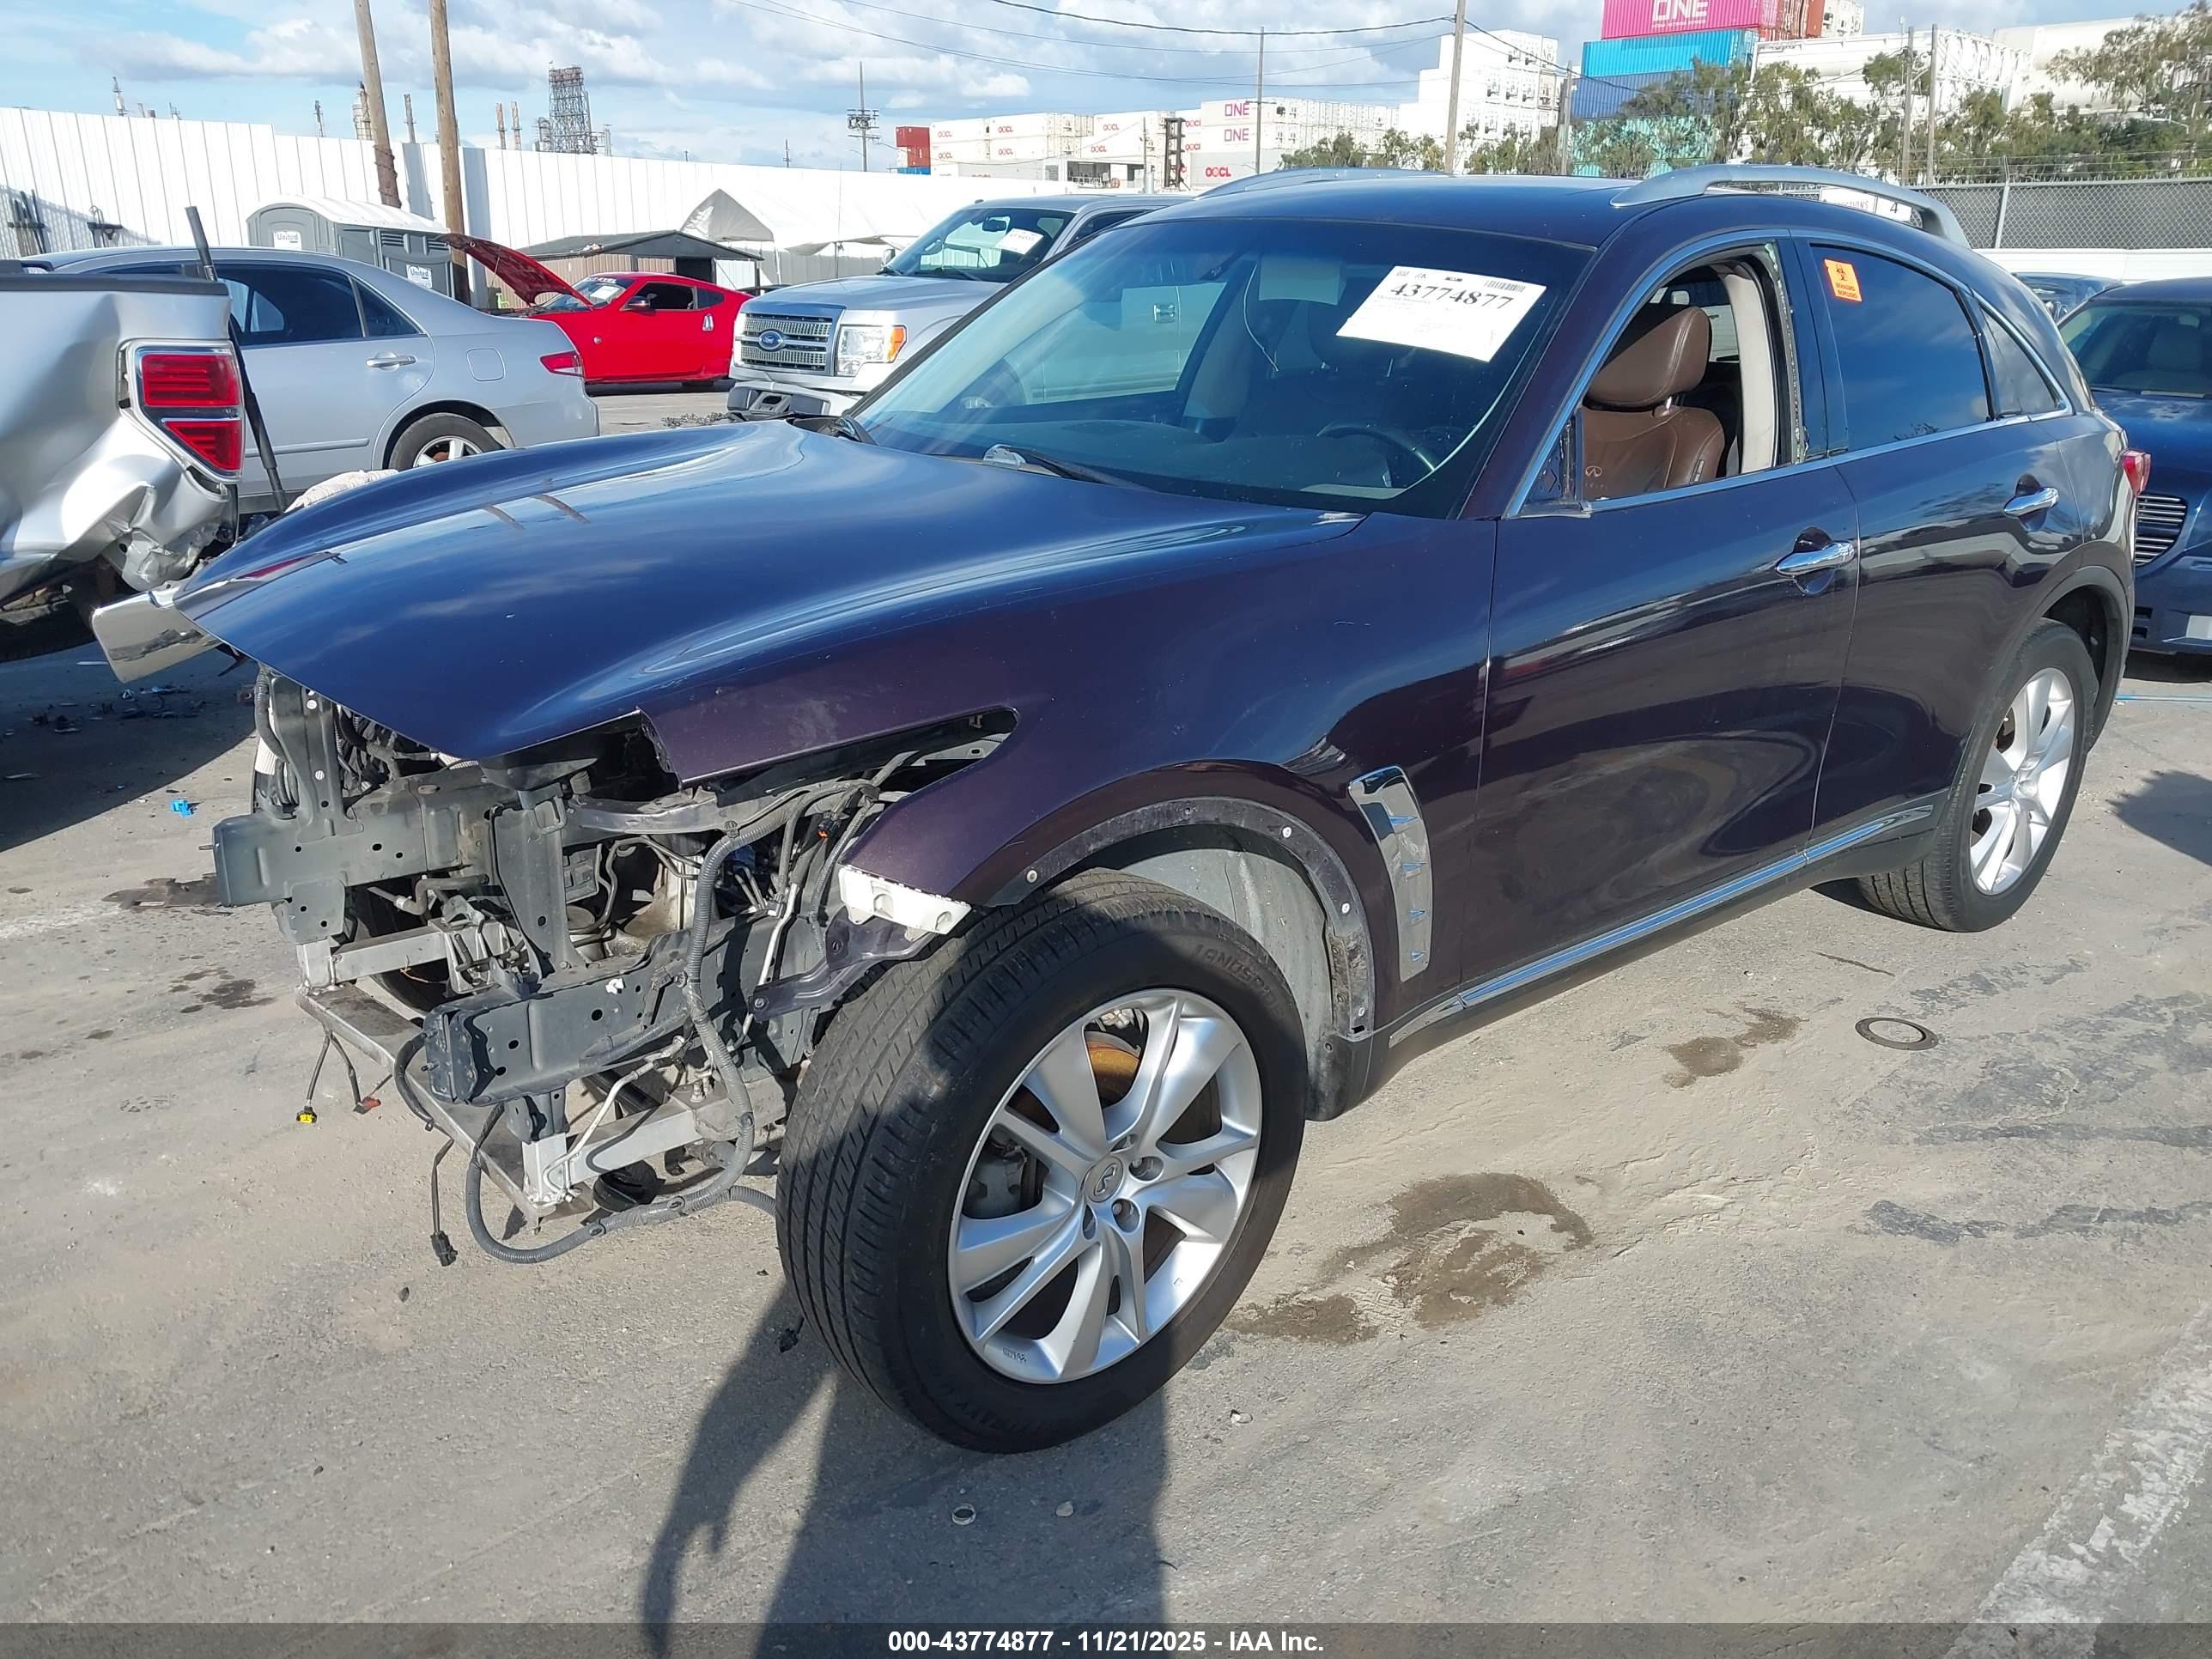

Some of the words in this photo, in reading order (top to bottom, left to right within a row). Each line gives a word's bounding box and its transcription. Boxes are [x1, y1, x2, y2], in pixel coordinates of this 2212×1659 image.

[1652, 0, 1708, 21] ONE
[1224, 103, 1249, 117] ONE
[1224, 128, 1249, 142] ONE
[1206, 167, 1231, 177] OOCL
[1889, 201, 1899, 214] 4
[1390, 282, 1515, 309] 43774877
